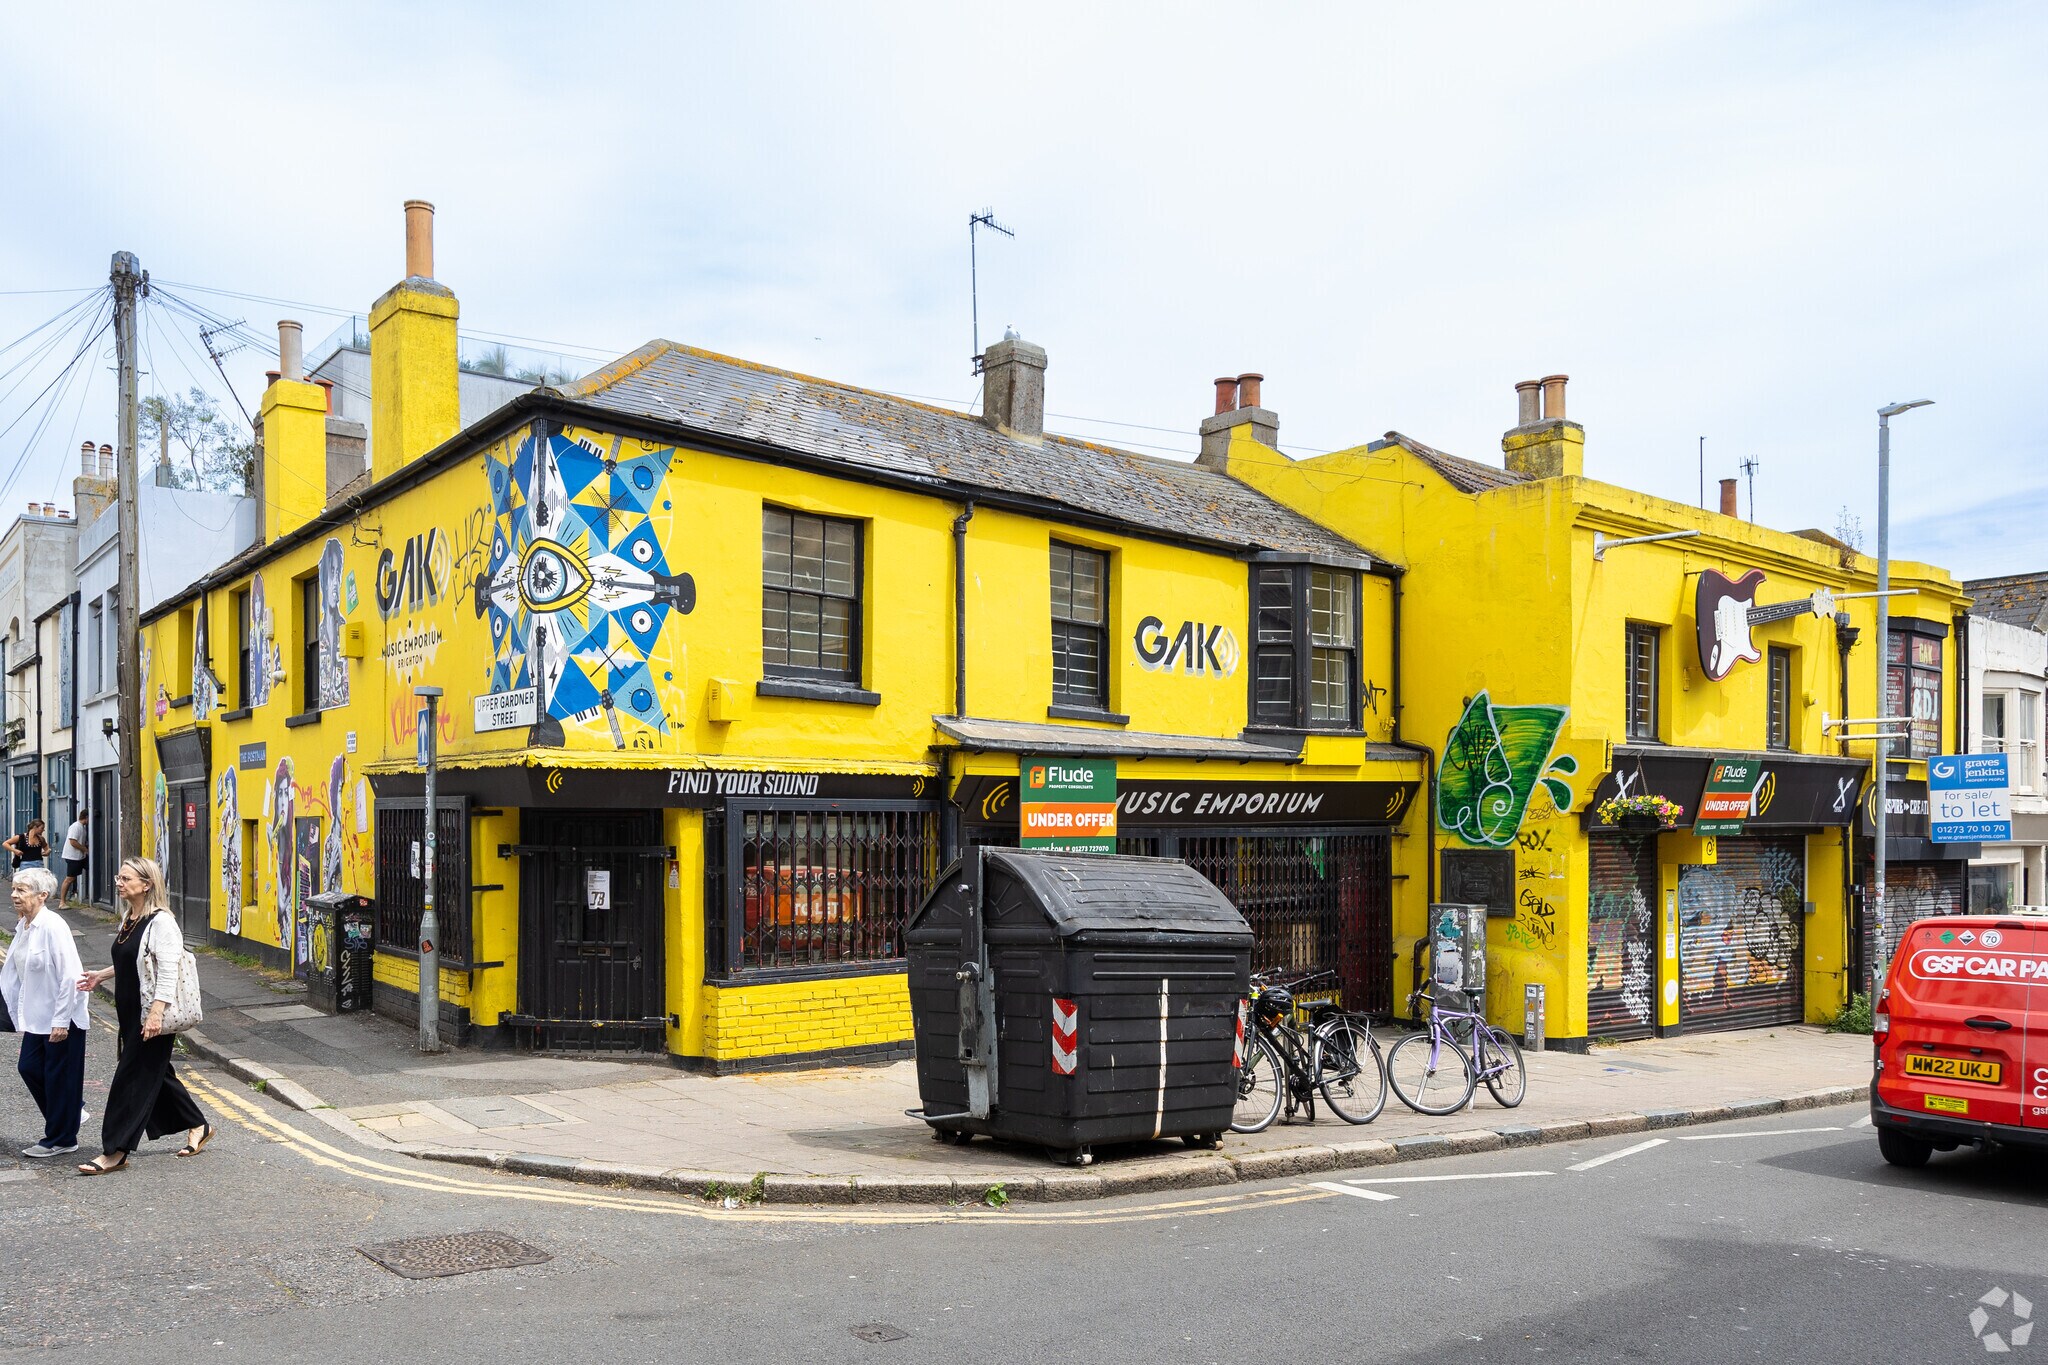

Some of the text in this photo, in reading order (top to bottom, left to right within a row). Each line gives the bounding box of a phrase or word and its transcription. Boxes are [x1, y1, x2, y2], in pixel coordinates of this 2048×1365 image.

[375, 527, 438, 615] GAK
[382, 630, 443, 658] MUSIC EMPORIUM
[1133, 616, 1223, 674] GAK
[397, 654, 424, 669] BRIGHTON
[1919, 643, 1933, 664] GAK
[1912, 676, 1922, 688] PRO
[1923, 678, 1938, 690] AUDIO
[477, 691, 535, 712] UPPER GARDNER
[492, 711, 517, 726] STREET
[1723, 765, 1748, 778] Flude
[1965, 759, 2000, 769] graves
[1048, 766, 1094, 782] Flude
[1965, 768, 2005, 778] jenkins
[667, 771, 819, 796] FIND YOUR SOUND
[1193, 792, 1325, 815] EMPORIUM
[1944, 790, 1993, 801] for sale/
[1705, 800, 1749, 812] UNDER OFFER
[1885, 798, 1928, 815] NSPIRE CREAT
[1940, 801, 2001, 818] to let
[1027, 812, 1115, 828] UNDER OFFER
[1937, 825, 1965, 834] 01273
[1966, 825, 1978, 833] 70
[1993, 824, 2006, 832] 70
[1937, 833, 2006, 841] www.gravesjenkins.com
[1985, 935, 1998, 944] 70
[1922, 955, 1965, 974] GSF
[1964, 957, 2016, 977] CAR
[1912, 1057, 1993, 1079] MW22 UKJ
